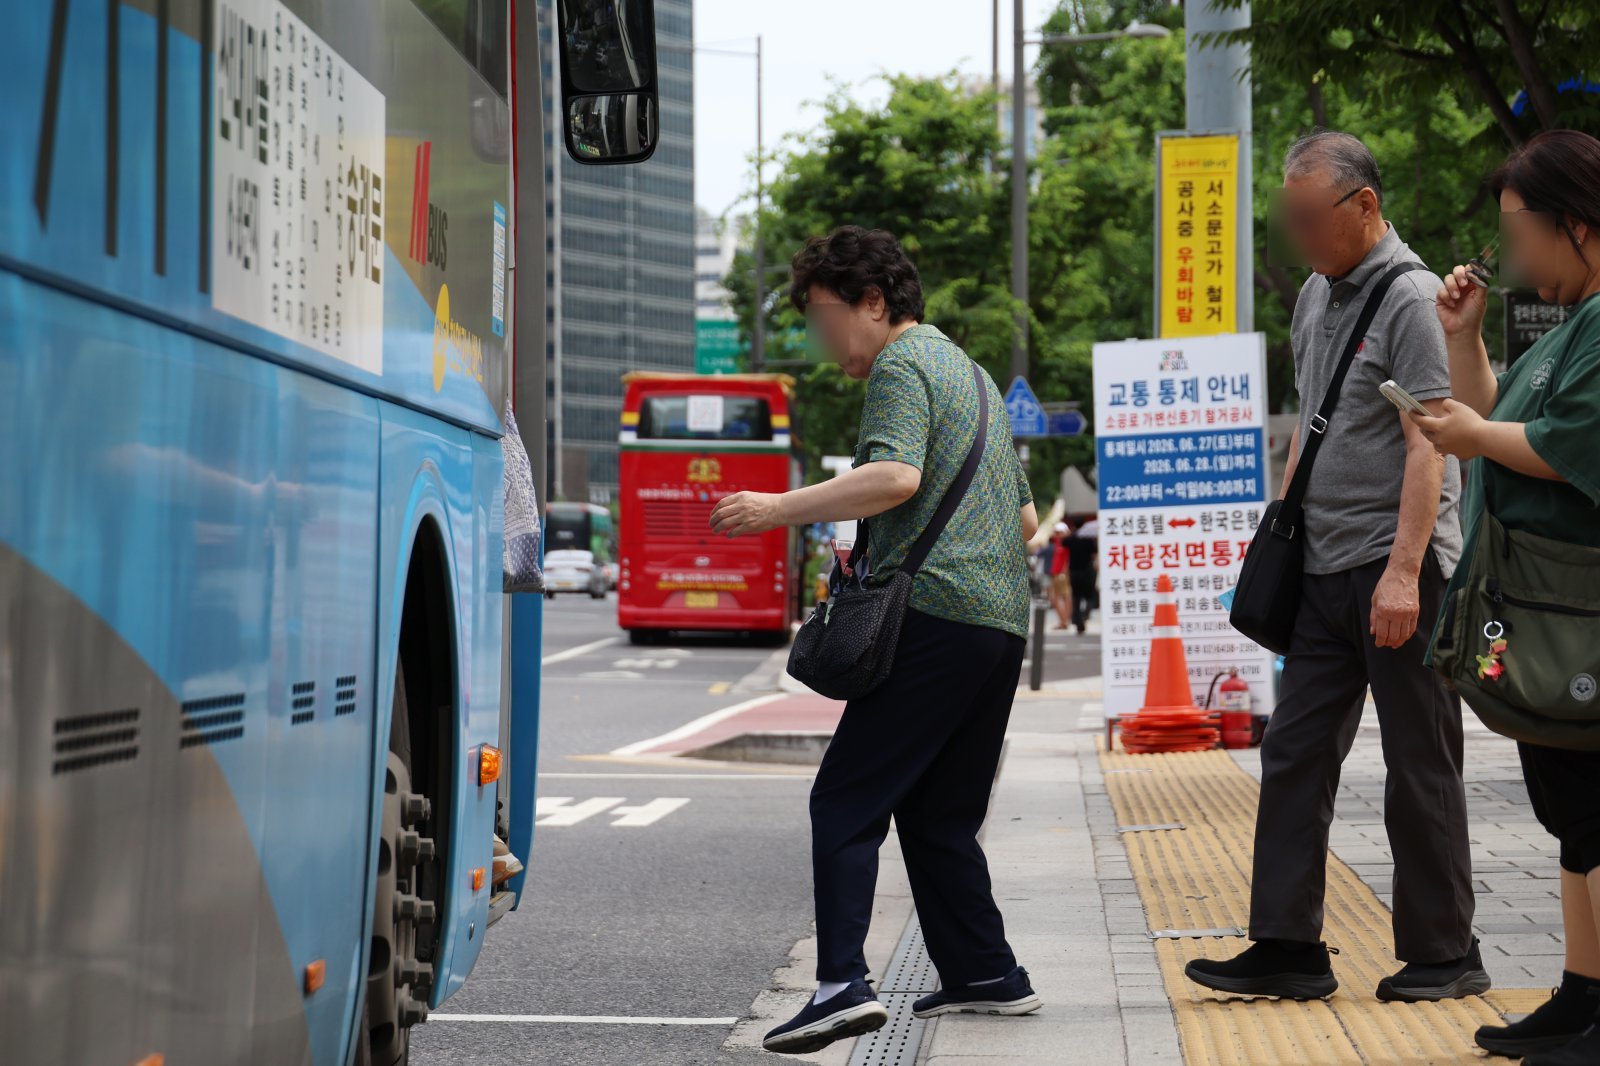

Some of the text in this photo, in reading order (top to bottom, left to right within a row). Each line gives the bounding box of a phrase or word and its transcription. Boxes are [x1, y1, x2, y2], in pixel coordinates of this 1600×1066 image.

[347, 154, 382, 285] 숭례문
[1177, 180, 1194, 237] 공사중
[1206, 179, 1223, 322] 서소문고가 철거
[1108, 373, 1250, 407] 교통 통제 안내
[1105, 412, 1139, 429] 소공로
[1143, 409, 1202, 427] 가변신호기
[1105, 439, 1147, 458] 통제일시
[1106, 509, 1260, 536] 조선호텔 한국은행
[1198, 573, 1240, 591] 바랍니
[1184, 597, 1224, 612] 죄송합
